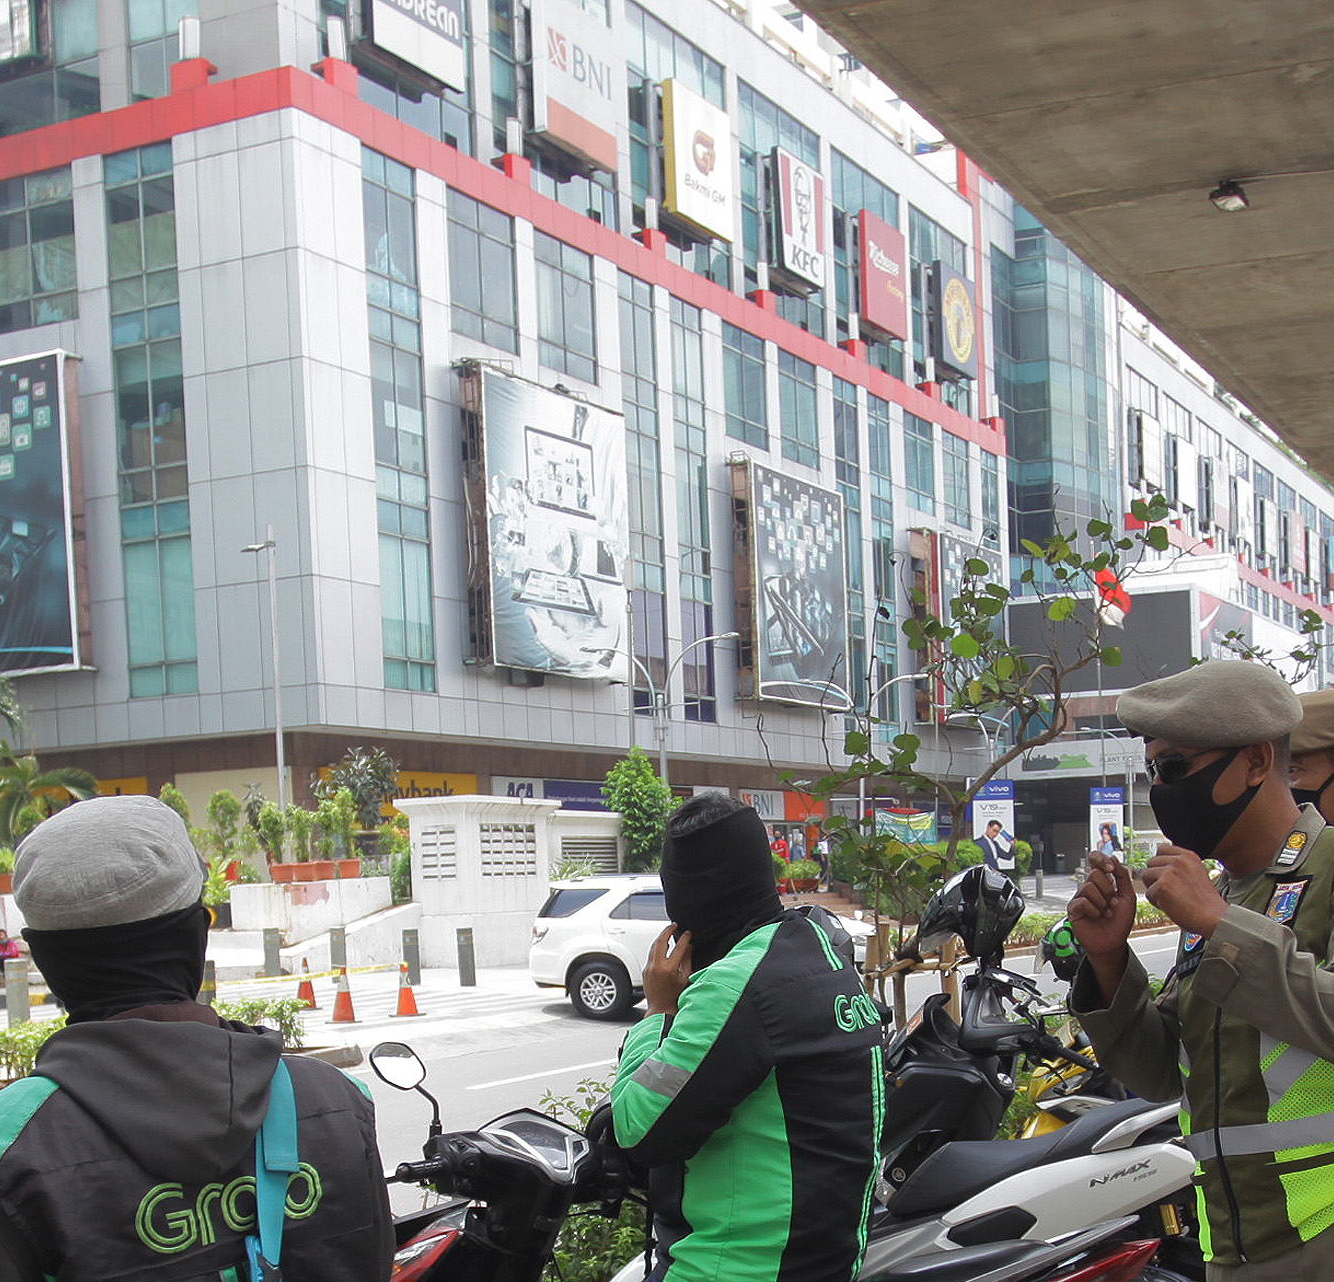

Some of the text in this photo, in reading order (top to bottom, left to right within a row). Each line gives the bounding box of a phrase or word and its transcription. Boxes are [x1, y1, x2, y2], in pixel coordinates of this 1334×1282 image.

[573, 44, 611, 101] BNI
[792, 243, 819, 278] KFC
[753, 794, 774, 817] BNI
